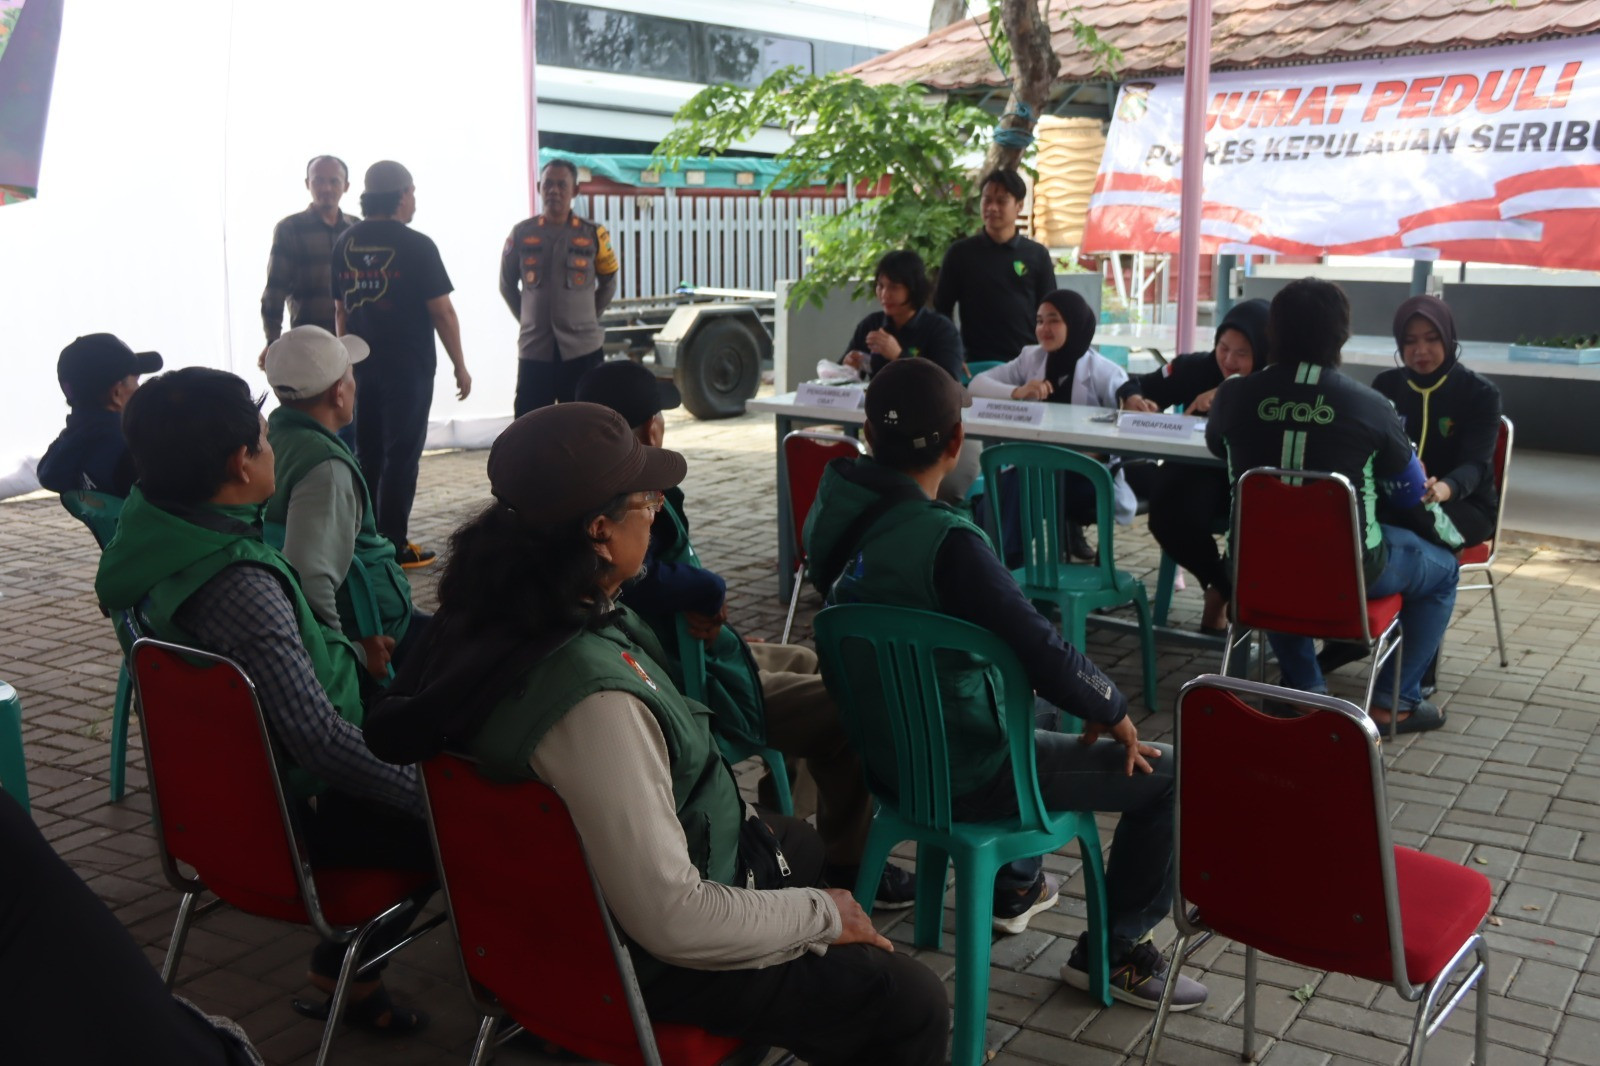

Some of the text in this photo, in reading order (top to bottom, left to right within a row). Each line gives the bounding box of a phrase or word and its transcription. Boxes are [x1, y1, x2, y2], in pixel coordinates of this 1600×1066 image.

[1203, 60, 1583, 133] JUMAT PEDULI
[1264, 126, 1459, 163] KEPULAUAN
[1470, 119, 1600, 154] SERIB
[1131, 419, 1183, 431] PENDAFTARAN
[1257, 394, 1335, 425] Grab
